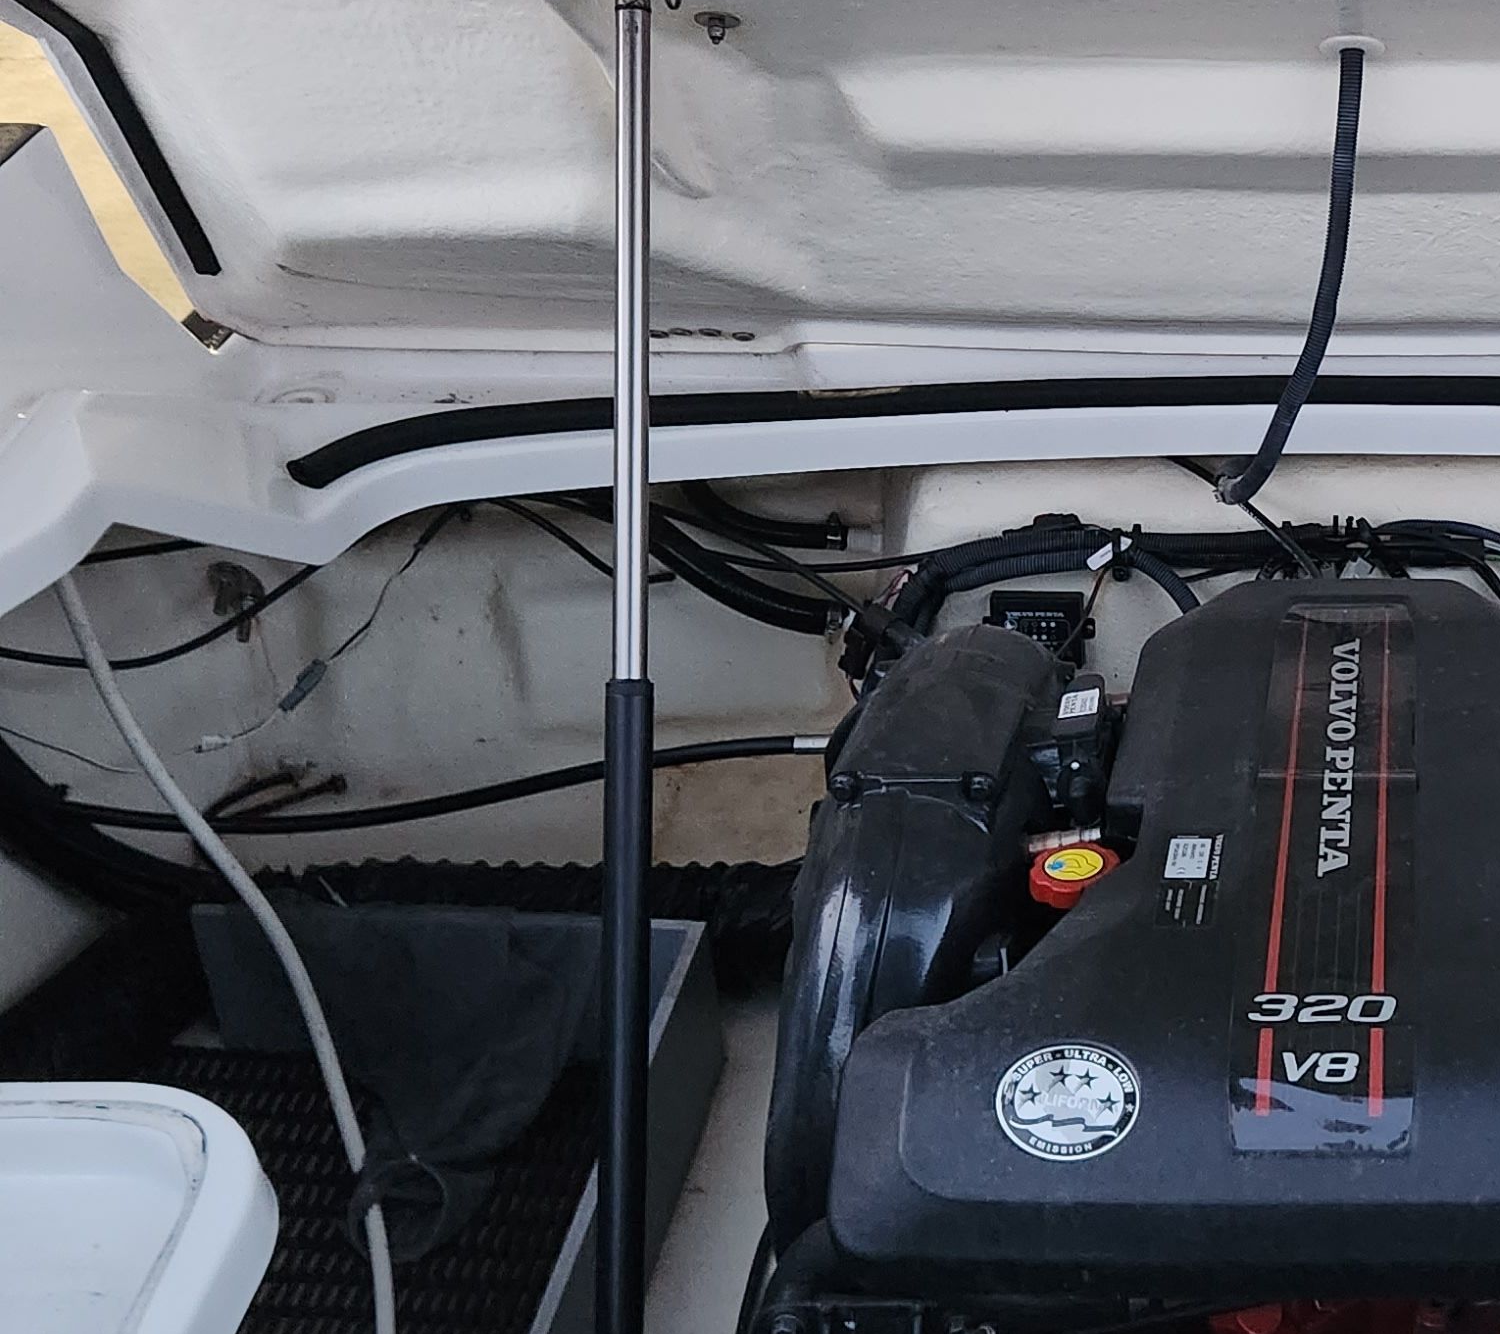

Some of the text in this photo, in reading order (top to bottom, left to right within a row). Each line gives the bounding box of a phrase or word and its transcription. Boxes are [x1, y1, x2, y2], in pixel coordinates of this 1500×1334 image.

[1316, 638, 1361, 878] VOLVO PENTA
[1247, 993, 1398, 1024] 320
[1012, 1049, 1134, 1094] SUPER ULTRA LOW
[1281, 1051, 1361, 1084] V8
[1028, 1136, 1093, 1154] EMISSION
